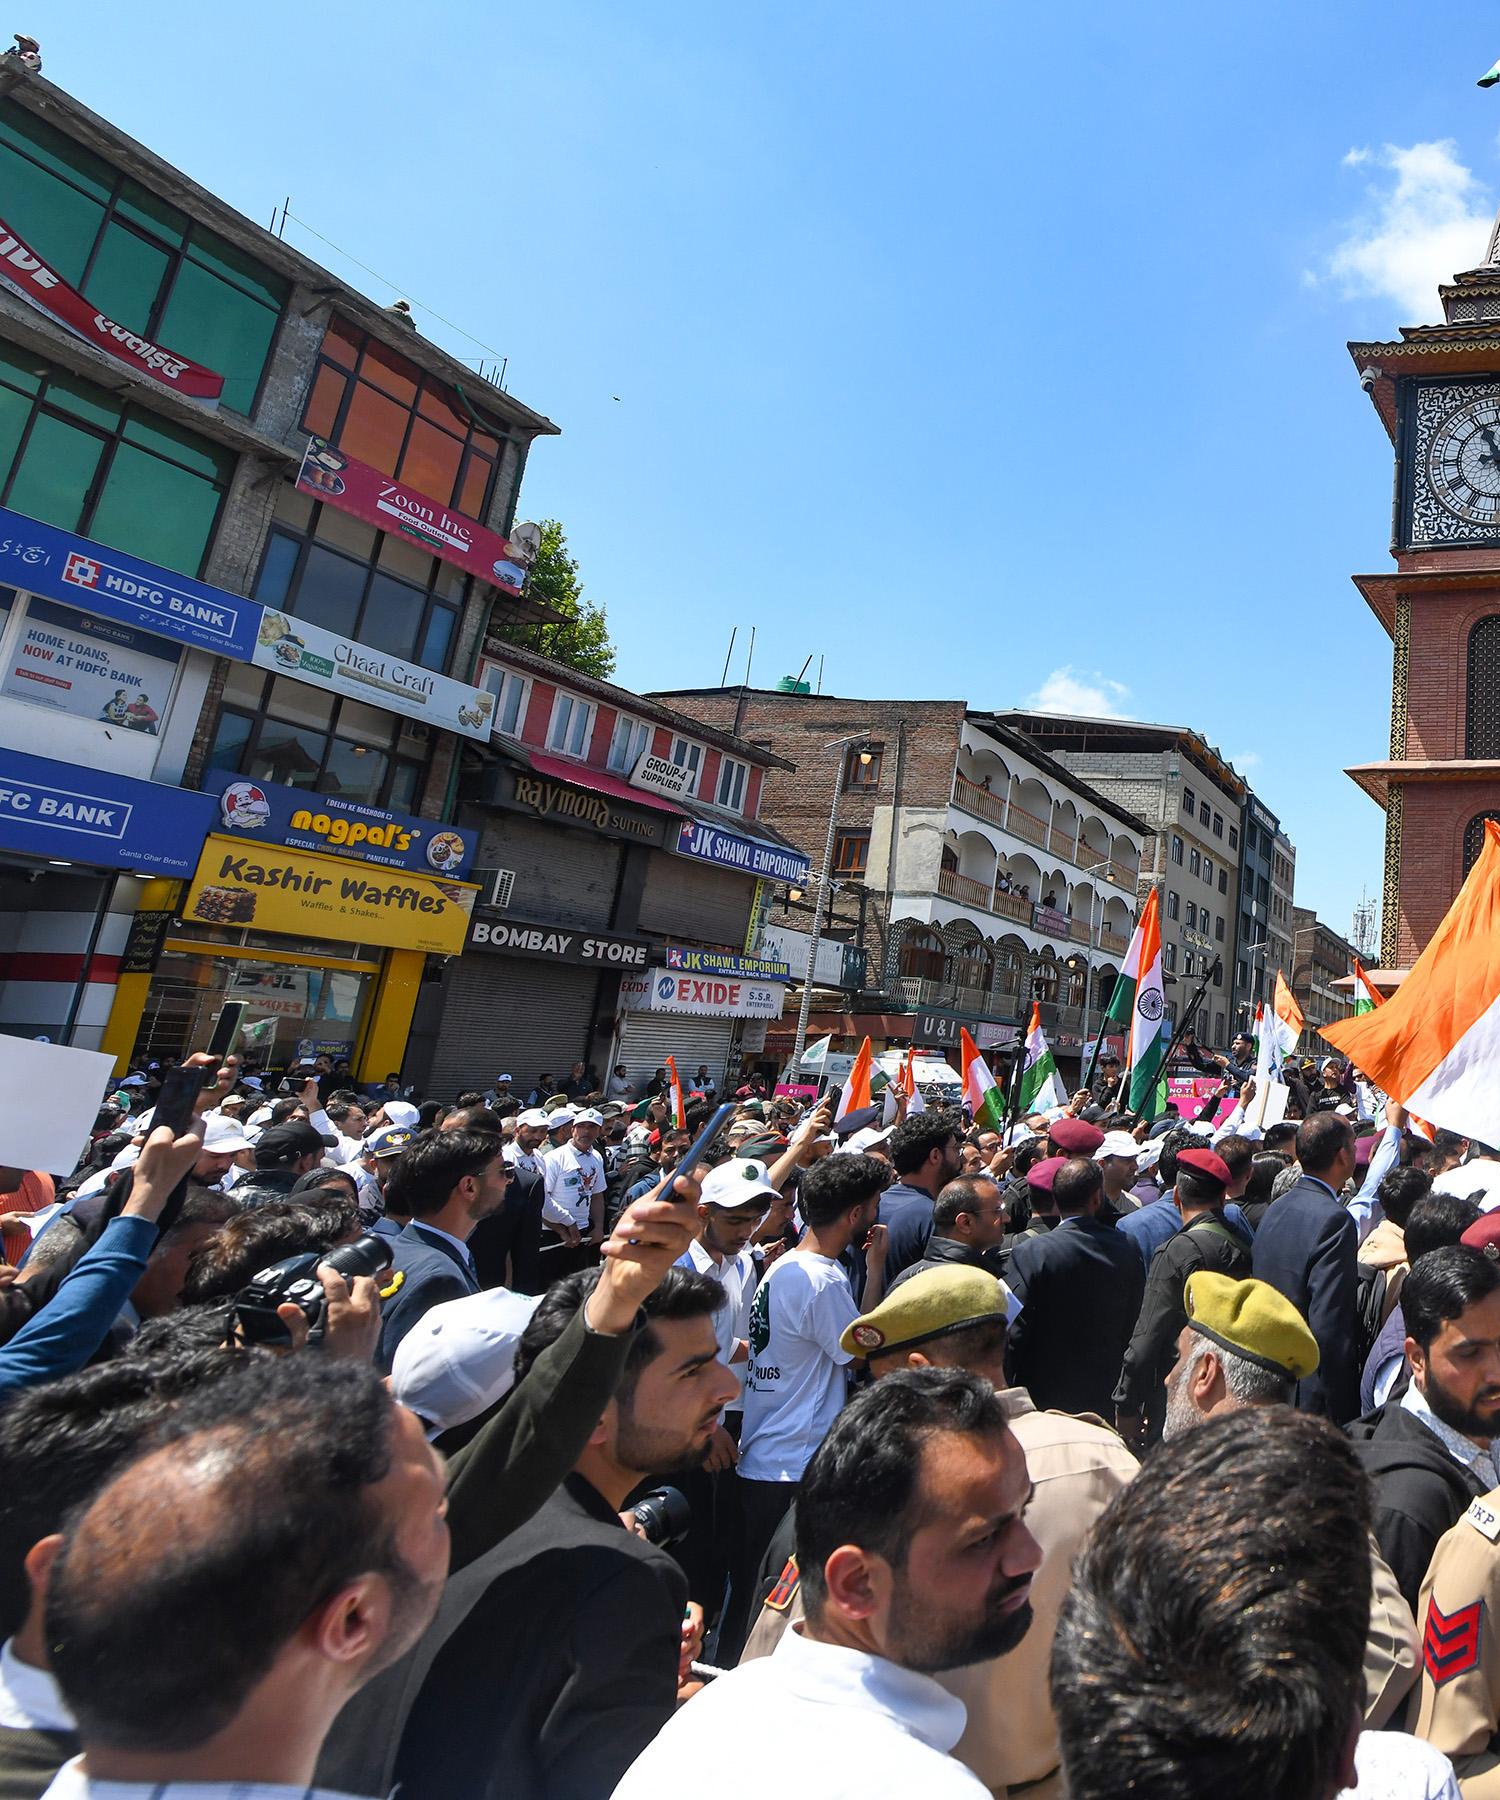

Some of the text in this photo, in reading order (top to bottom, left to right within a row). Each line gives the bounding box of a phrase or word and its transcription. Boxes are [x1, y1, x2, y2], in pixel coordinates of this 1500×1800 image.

[377, 480, 474, 544] Zoon Inc.
[398, 512, 449, 542] Food Outlets
[105, 574, 225, 627] HDFC BANK
[27, 629, 111, 664] HOME LOANS,
[224, 638, 244, 651] Branch
[23, 644, 143, 688] NOW AT HDFC BANK
[334, 643, 385, 678] Chaat
[391, 666, 435, 696] Craft
[640, 770, 682, 792] SUPPLIERS
[646, 758, 687, 782] GROUP-4
[38, 798, 116, 827] BANK
[290, 810, 412, 851] nagpal's
[611, 815, 655, 837] SUITING
[119, 848, 189, 868] Ganta Ghar Branch
[290, 838, 316, 850] SPECIAL
[366, 853, 389, 864] PANEER
[690, 827, 806, 880] JK SHAWL EMPORIUM
[219, 854, 448, 916] Kashir Waffles
[301, 899, 333, 912] Waffles
[339, 905, 347, 914] &
[472, 923, 572, 955] BOMBAY
[581, 940, 647, 965] STORE
[682, 953, 788, 975] JK SHAWL EMPORIUM
[718, 968, 746, 977] ENTRANCE
[621, 981, 650, 993] EXIDE
[677, 979, 741, 1006] EXIDE
[923, 1017, 935, 1035] U
[937, 1019, 946, 1036] &
[981, 1027, 1011, 1040] LIBERTY
[755, 1366, 781, 1380] RUGS
[1468, 1503, 1495, 1526] JKP
